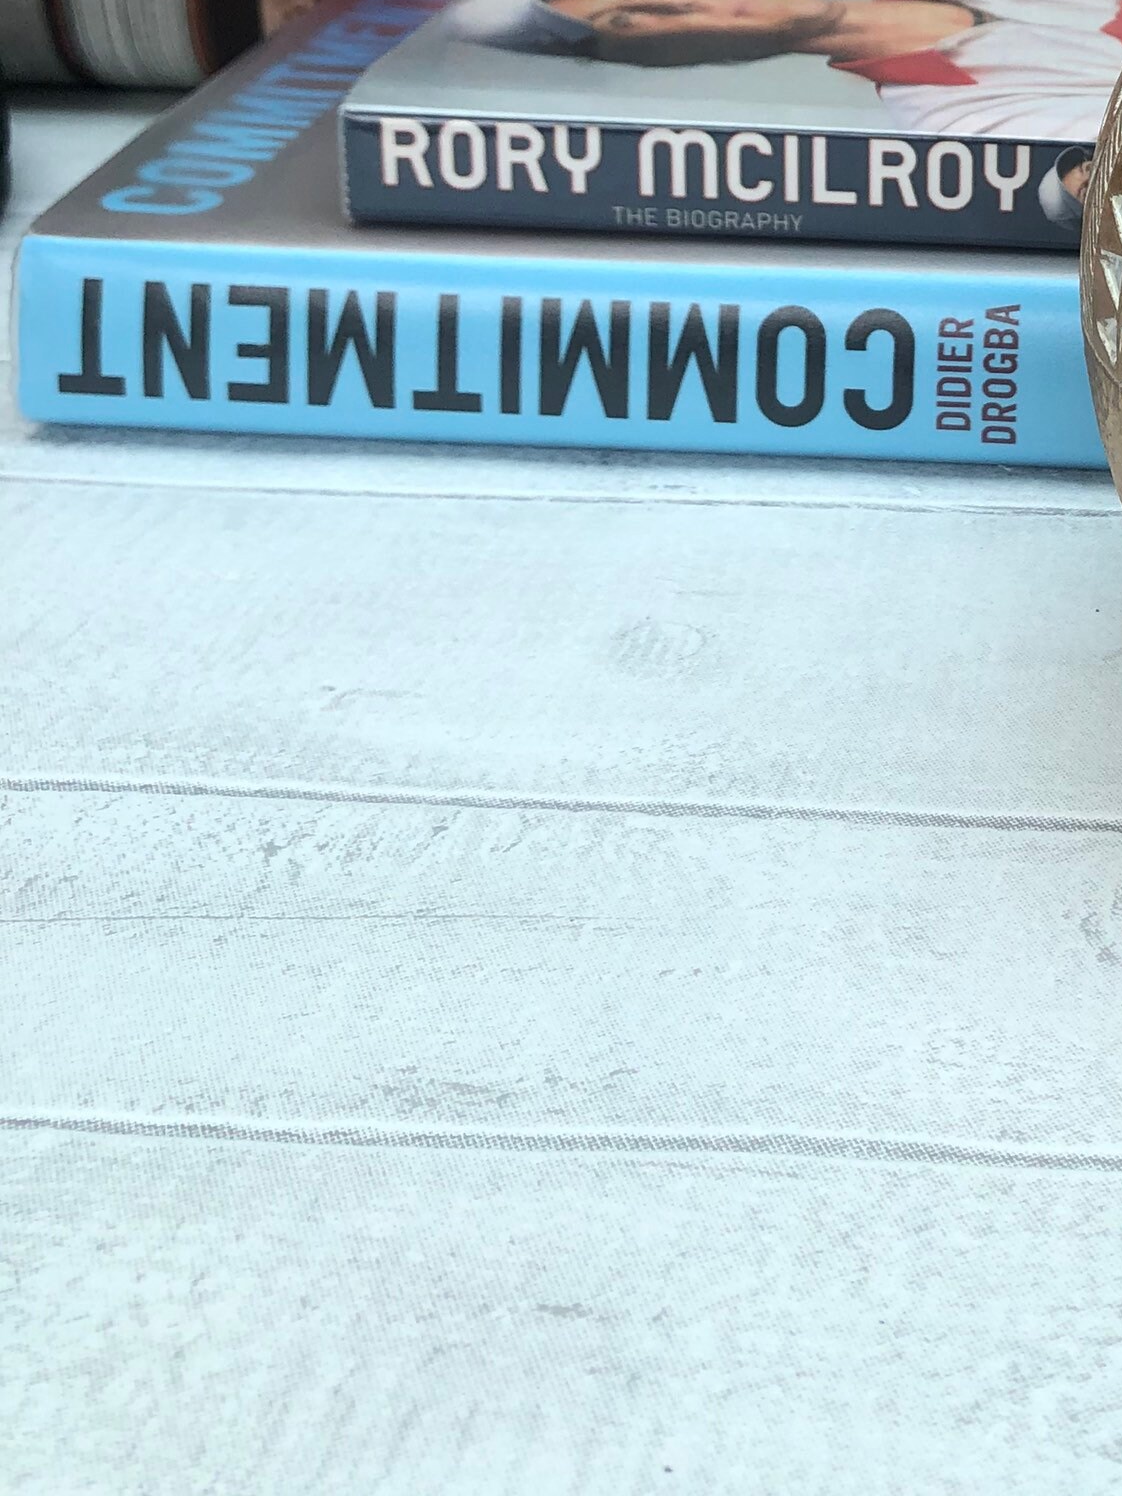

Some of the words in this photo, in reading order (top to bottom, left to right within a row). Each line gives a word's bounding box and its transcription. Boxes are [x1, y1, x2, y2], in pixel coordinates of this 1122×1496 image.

[378, 116, 602, 195] RORY
[637, 126, 1031, 213] MCILROY
[612, 205, 658, 228] THE
[666, 208, 804, 232] BIOGRAPHY
[57, 277, 916, 431] COMMITMENT
[936, 316, 974, 431] DIDIER
[980, 303, 1021, 444] DROGBA
